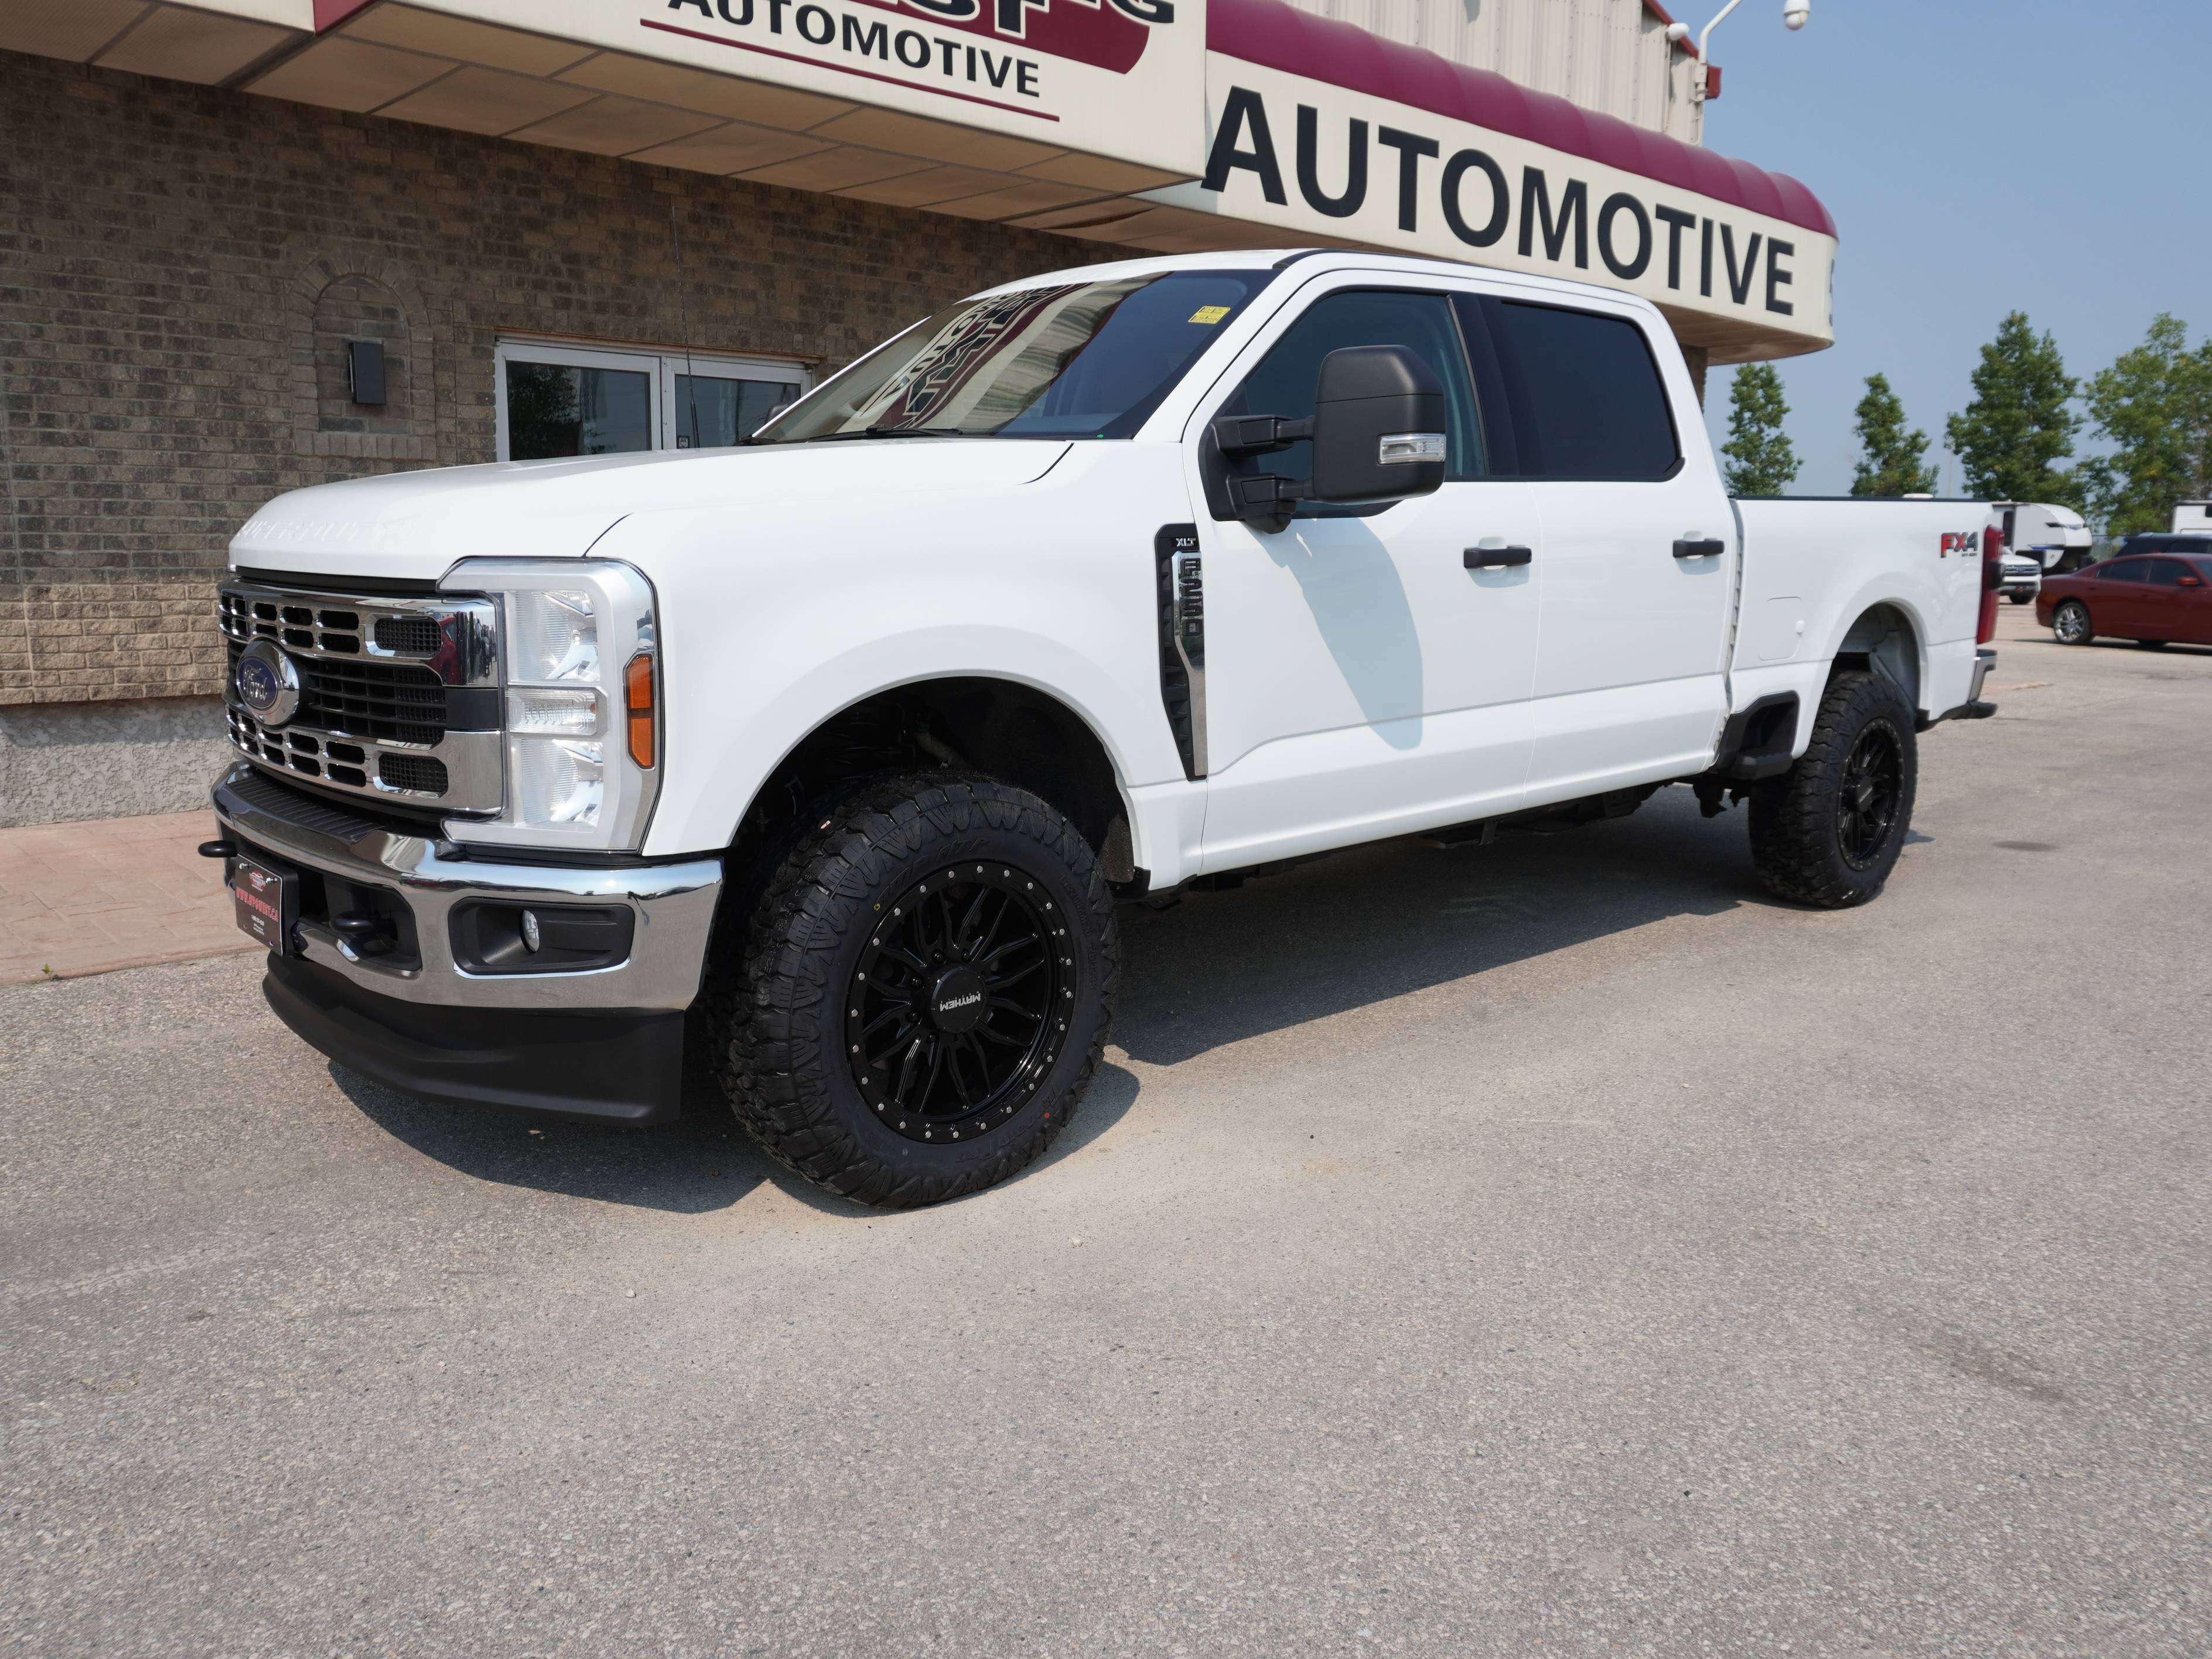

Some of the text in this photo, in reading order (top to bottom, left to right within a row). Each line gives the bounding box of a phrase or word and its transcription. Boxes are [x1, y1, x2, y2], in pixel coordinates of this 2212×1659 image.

[1200, 85, 1795, 316] AUTOMOTIVE
[1176, 537, 1197, 547] XLT
[1940, 531, 1978, 558] FX4
[940, 991, 981, 1012] MAYHEM
